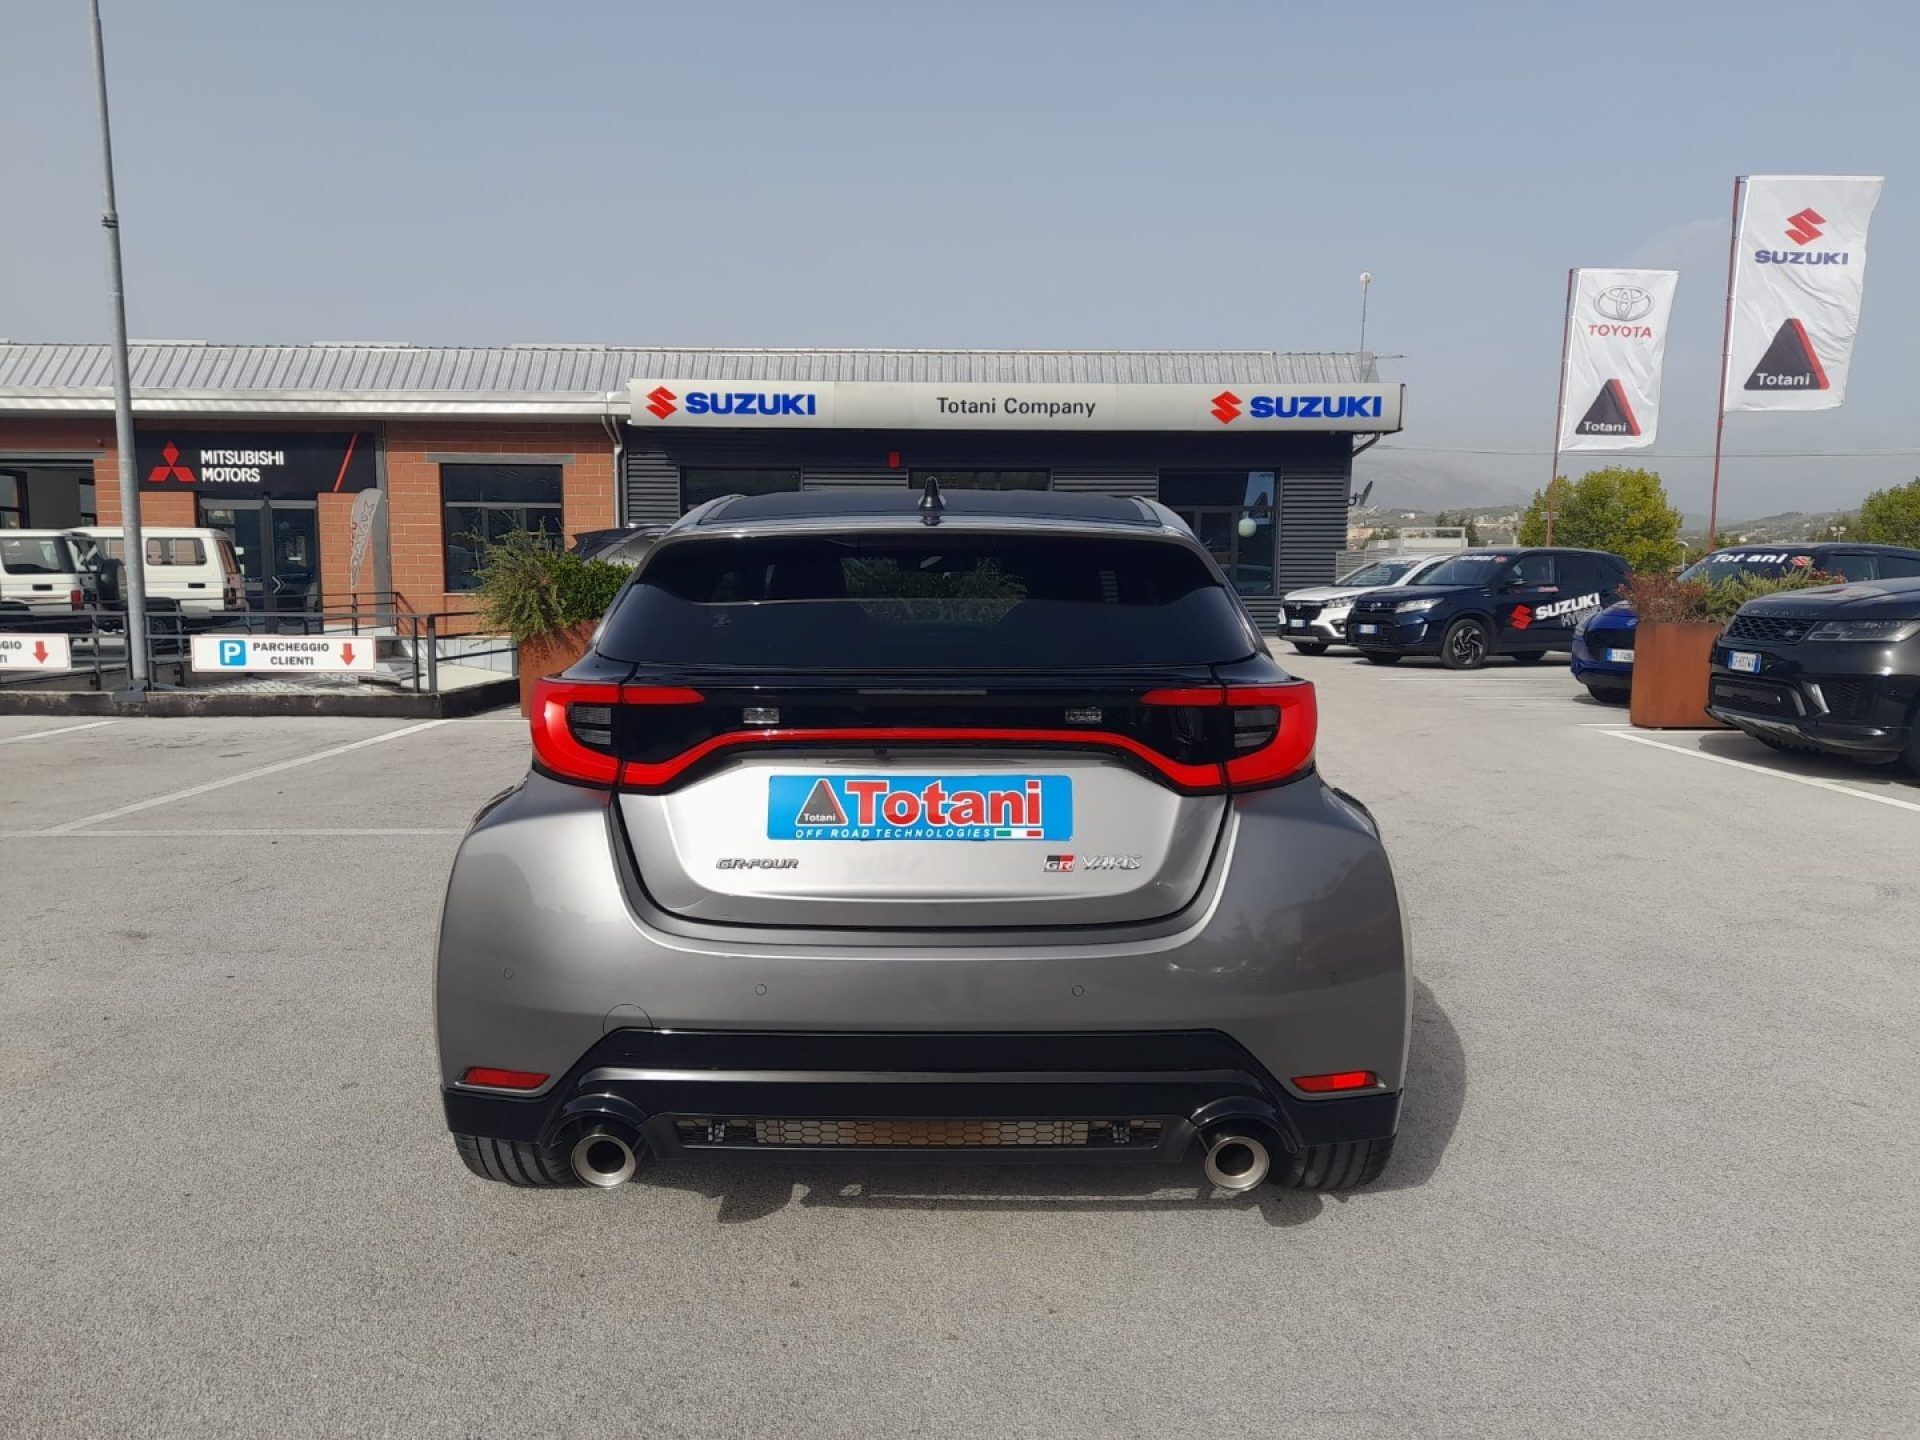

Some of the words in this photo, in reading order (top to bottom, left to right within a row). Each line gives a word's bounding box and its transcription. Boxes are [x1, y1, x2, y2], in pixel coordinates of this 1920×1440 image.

[1755, 250, 1849, 265] SUZUKI
[1588, 324, 1652, 338] TOYOTA
[1756, 372, 1810, 386] Totani
[685, 392, 816, 415] SUZUKI
[936, 397, 996, 414] Totani
[1004, 397, 1096, 418] Company
[1250, 396, 1382, 418] SUZUKI
[1583, 421, 1627, 432] Totani
[200, 450, 285, 465] MITSUBISHI
[202, 467, 261, 482] MOTORS
[1535, 592, 1601, 620] SUZUKI
[0, 640, 22, 650] GIO
[252, 642, 330, 652] PARCHEGGIO
[223, 642, 241, 664] P
[270, 656, 314, 666] CLIENTI
[845, 779, 1042, 826] Totani
[803, 813, 836, 822] Totani
[795, 828, 823, 838] OFF
[830, 828, 870, 838] ROAD
[875, 828, 991, 838] TECHNOLOGIES
[1045, 860, 1074, 871] GR
